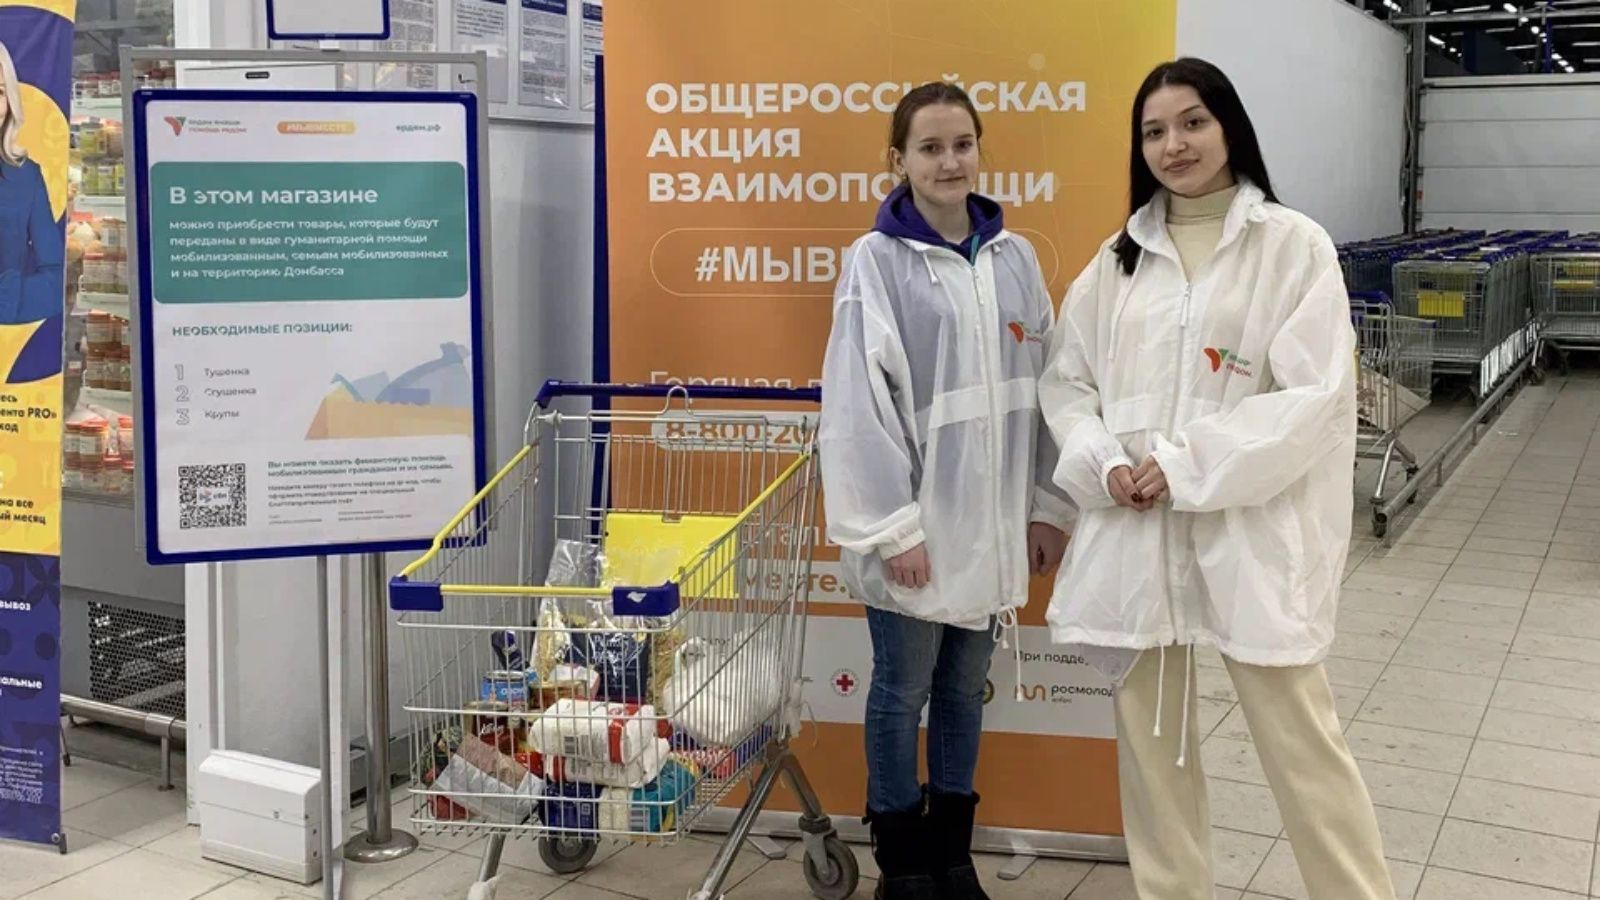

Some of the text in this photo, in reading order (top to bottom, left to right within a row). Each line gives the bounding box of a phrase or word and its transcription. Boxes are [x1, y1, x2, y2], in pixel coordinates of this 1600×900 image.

[646, 73, 1086, 118] ОБЩЕРОСССКАЯ
[646, 128, 801, 163] АКЦИЯ
[169, 186, 379, 205] В этом магазине
[648, 171, 1055, 207] ВЗАИМОПОЩИ
[169, 217, 440, 231] можно приобрести товары, которые будут
[169, 234, 428, 248] переданы в виде гуманитарной помощи
[170, 249, 449, 262] мобилизованным, семьям мобилизованных
[694, 246, 849, 283] #МЫВ
[171, 265, 346, 280] и на территорию Донбасса
[172, 322, 353, 337] НЕОБХОДИМЫЕ ПОЗИЦИИ:
[174, 363, 185, 381] 1
[174, 384, 190, 403] 2
[175, 407, 240, 426] 3 Крупы
[13, 513, 46, 525] месяц
[1043, 652, 1089, 666] подде
